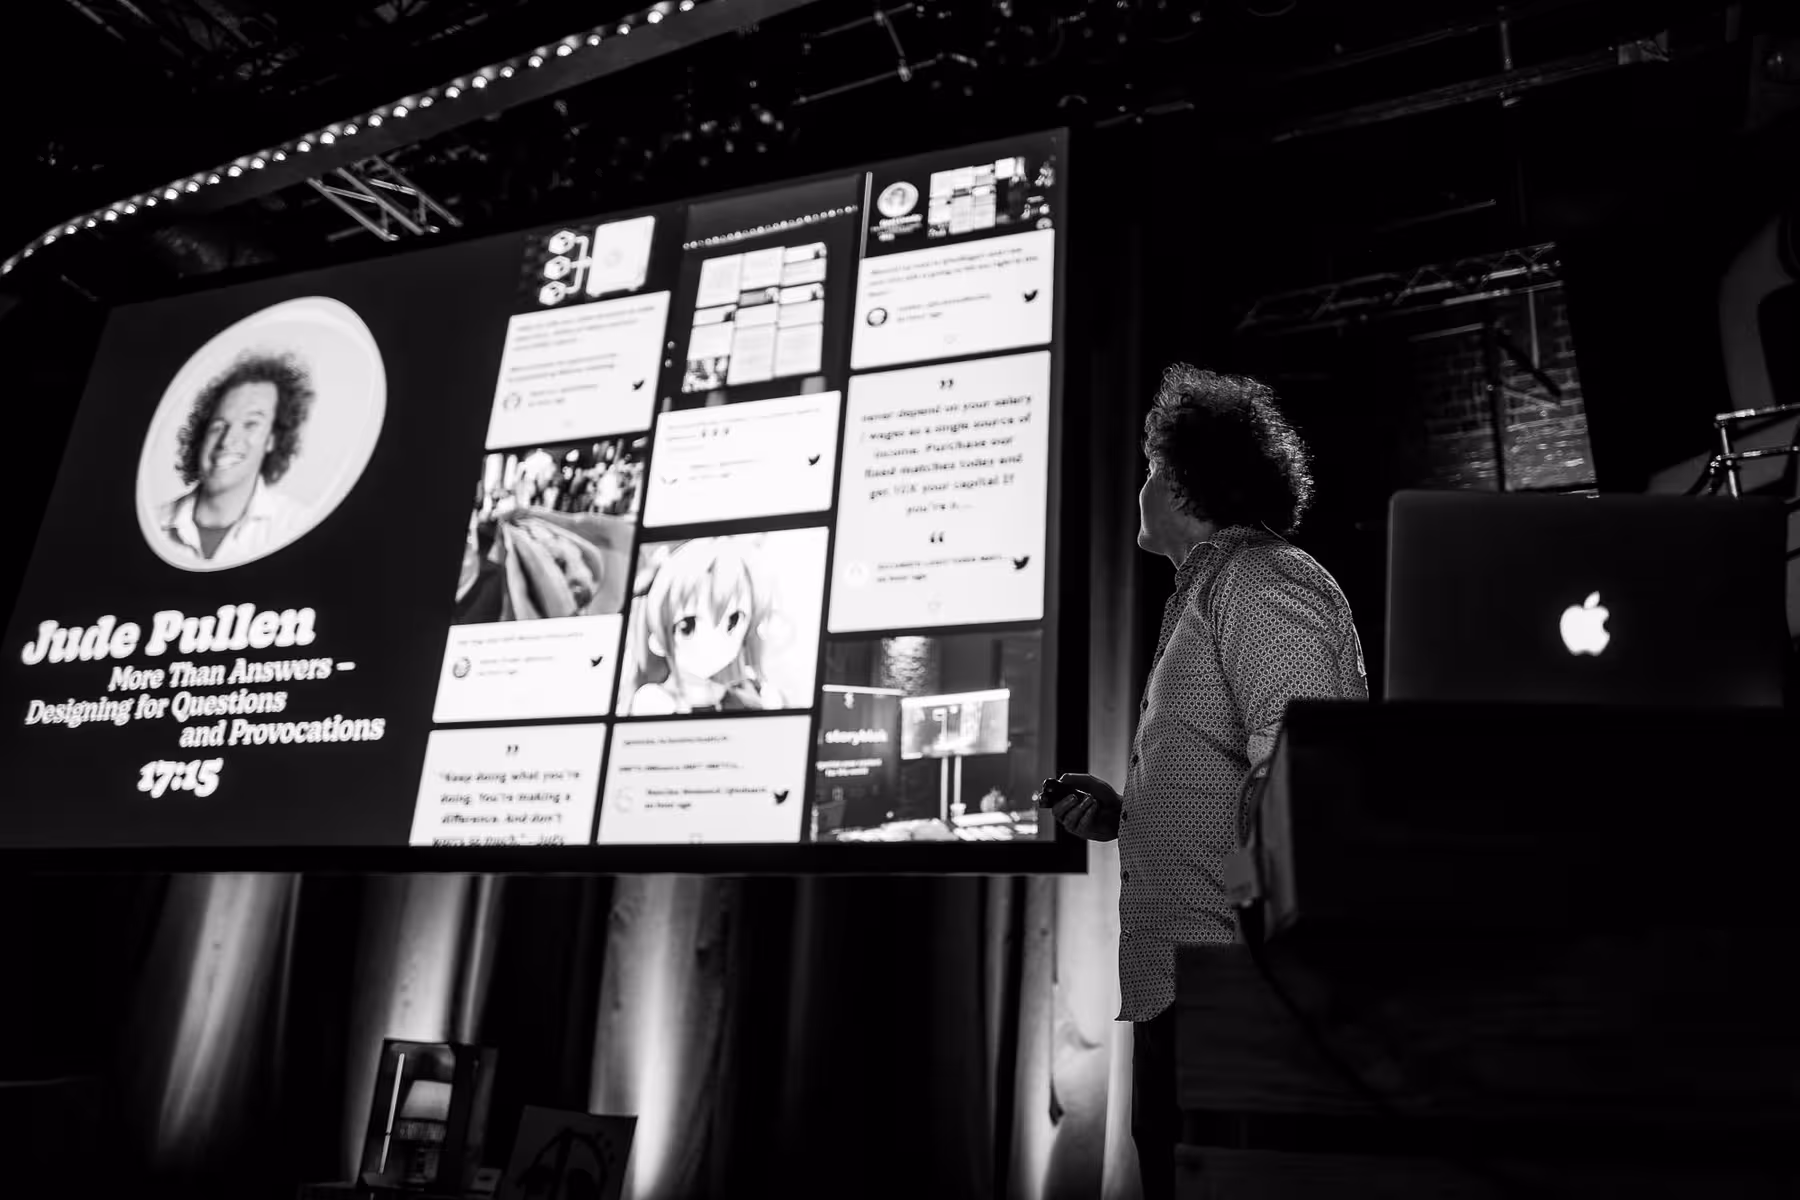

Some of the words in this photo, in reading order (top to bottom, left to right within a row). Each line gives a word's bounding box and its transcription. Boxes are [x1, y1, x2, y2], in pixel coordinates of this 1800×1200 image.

[20, 614, 141, 666] Jude
[144, 602, 317, 656] Pullen
[108, 665, 164, 692] More
[168, 661, 230, 688] Than
[227, 656, 332, 685] Answers
[24, 696, 135, 728] Designing
[135, 696, 169, 719] for
[171, 688, 288, 723] Questions
[179, 719, 227, 748] and
[228, 713, 386, 746] Provocations
[137, 757, 224, 798] 17:15
